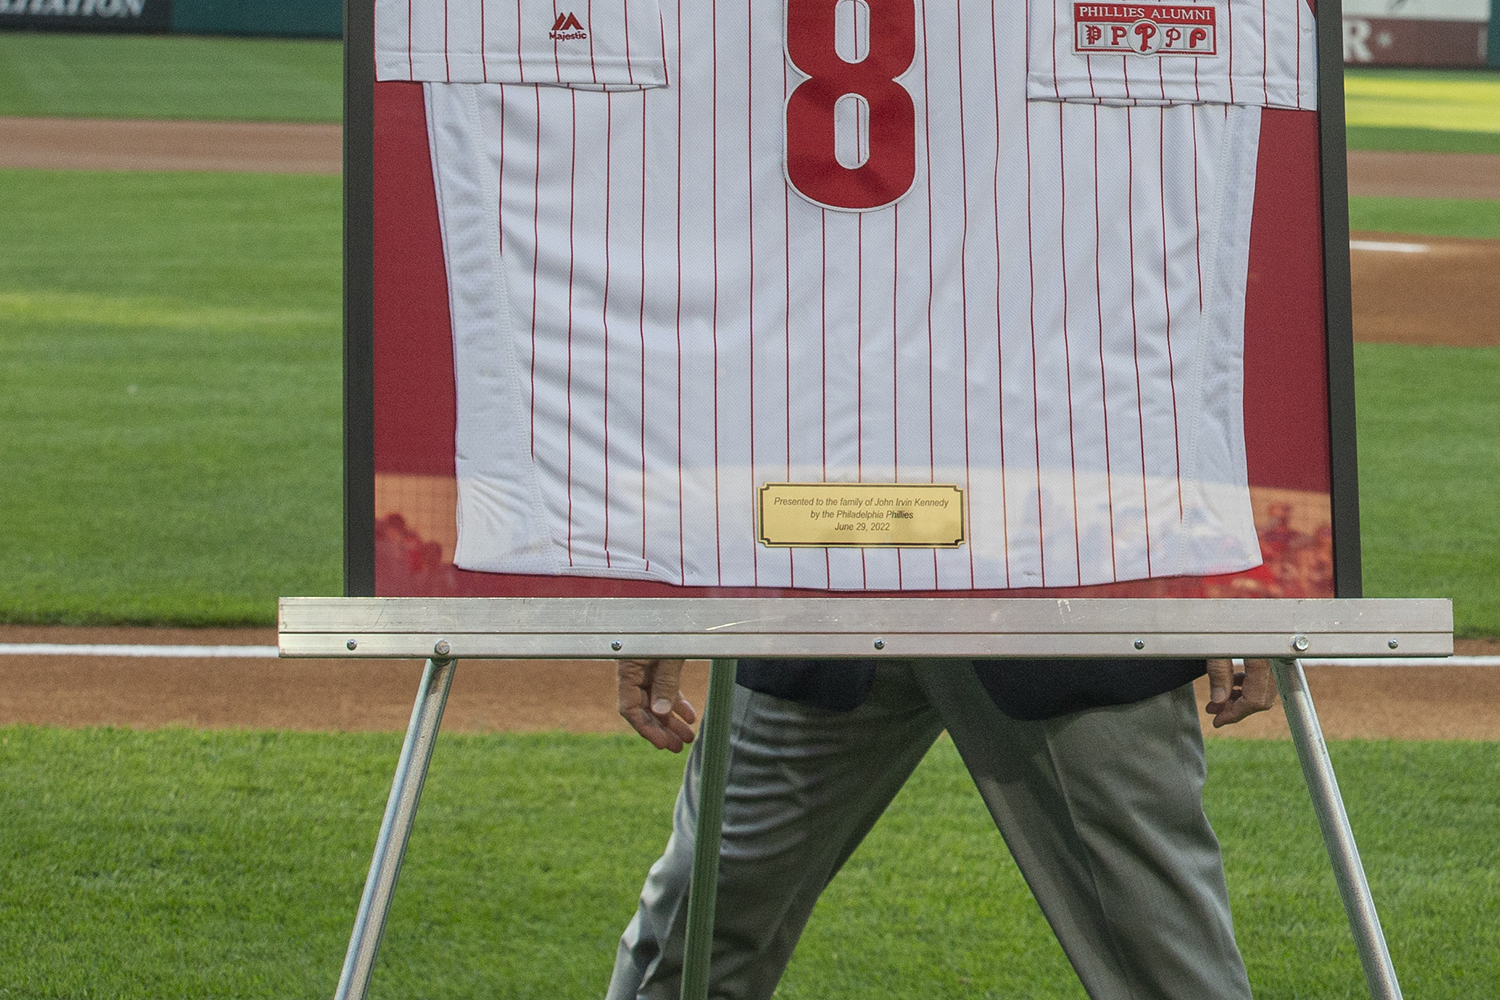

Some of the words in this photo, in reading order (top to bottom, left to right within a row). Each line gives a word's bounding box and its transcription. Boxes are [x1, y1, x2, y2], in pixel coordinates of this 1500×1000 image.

[1079, 6, 1145, 18] PHILLIES
[1150, 8, 1211, 21] ALUMNI
[549, 32, 588, 42] Majestic
[773, 496, 814, 506] Presented
[816, 498, 824, 506] to
[825, 498, 838, 506] the
[840, 498, 863, 508] family
[865, 498, 873, 506] of
[874, 498, 894, 507] John
[895, 498, 912, 507] Irvin
[914, 499, 949, 509] Kennedy
[810, 510, 820, 520] by
[822, 510, 835, 518] the
[836, 510, 884, 520] Philadelphia
[886, 510, 914, 519] Phillies
[834, 522, 854, 531] June
[856, 522, 868, 532] 29,
[870, 522, 890, 531] 2022
